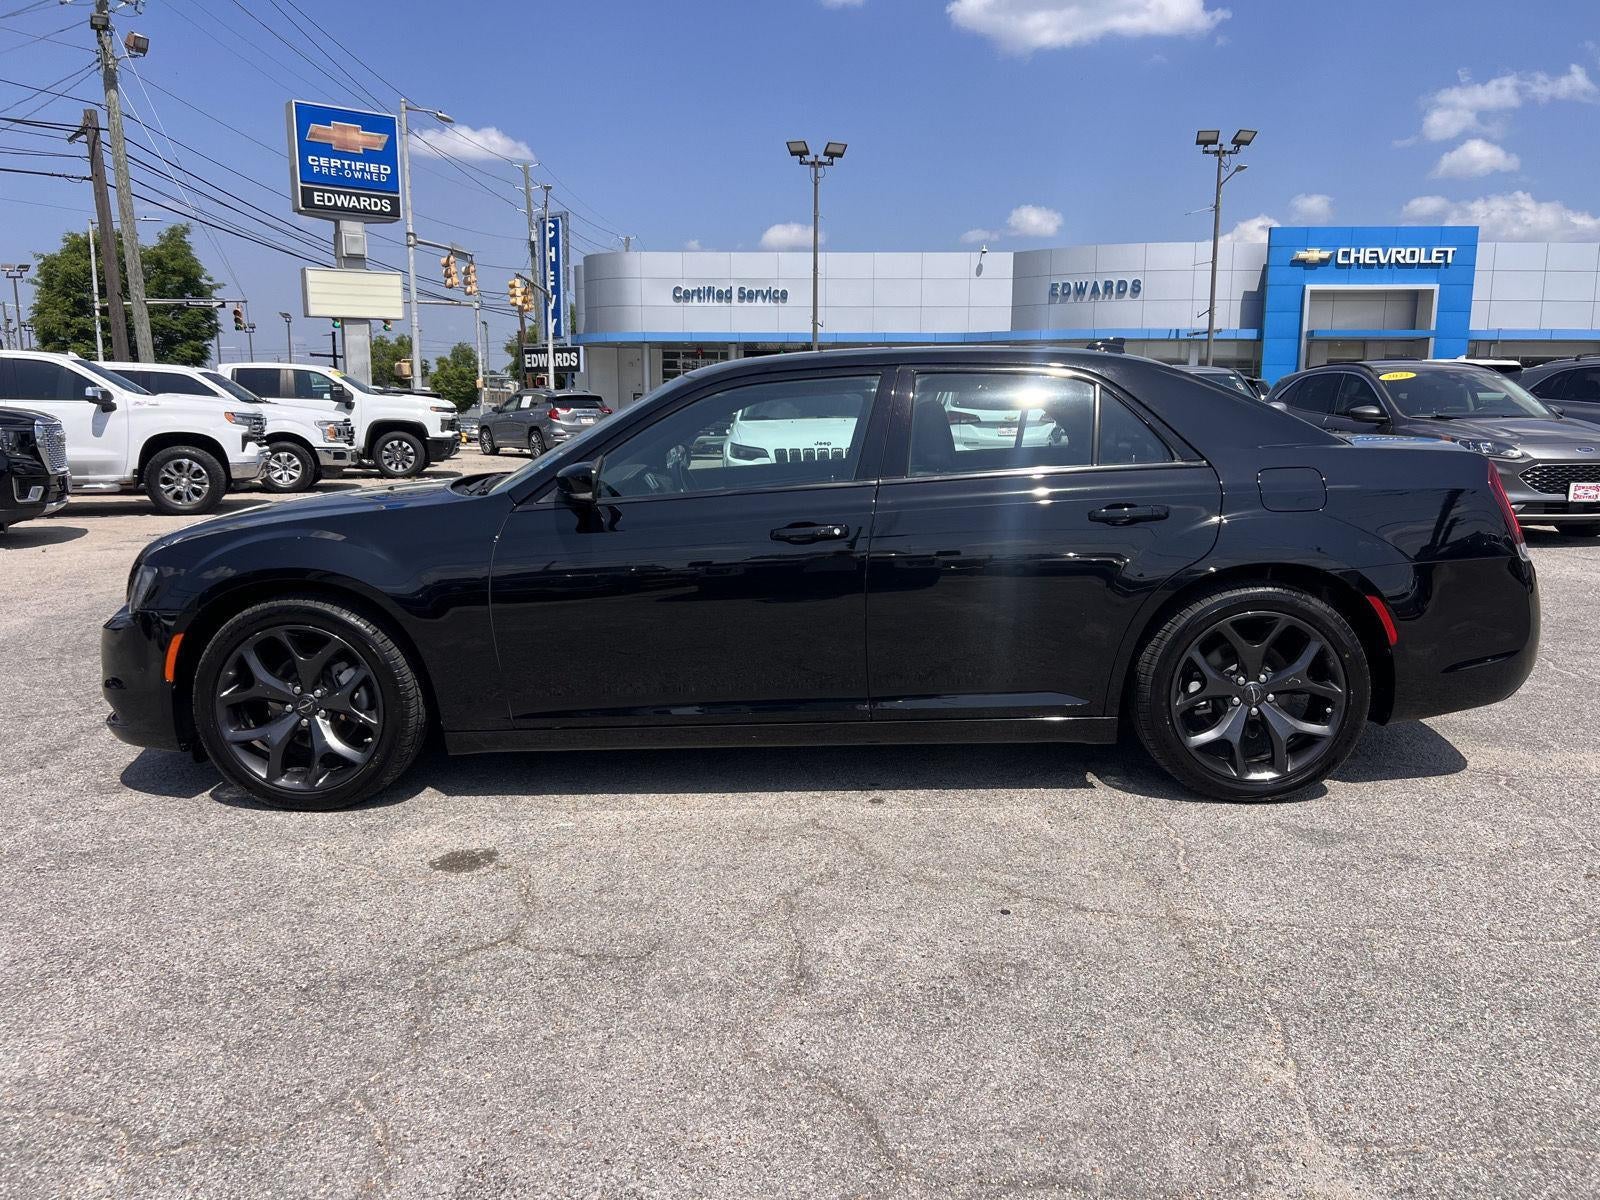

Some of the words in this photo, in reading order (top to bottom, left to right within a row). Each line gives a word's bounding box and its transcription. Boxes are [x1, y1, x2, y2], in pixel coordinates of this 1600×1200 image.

[307, 155, 391, 175] CERTIFIED
[313, 166, 387, 182] PRE-OWNED
[313, 191, 391, 212] EDWARDS
[1337, 247, 1457, 264] CHEVROLET
[672, 286, 733, 302] Certified
[737, 286, 788, 302] Service
[1049, 279, 1142, 299] EDWARDS
